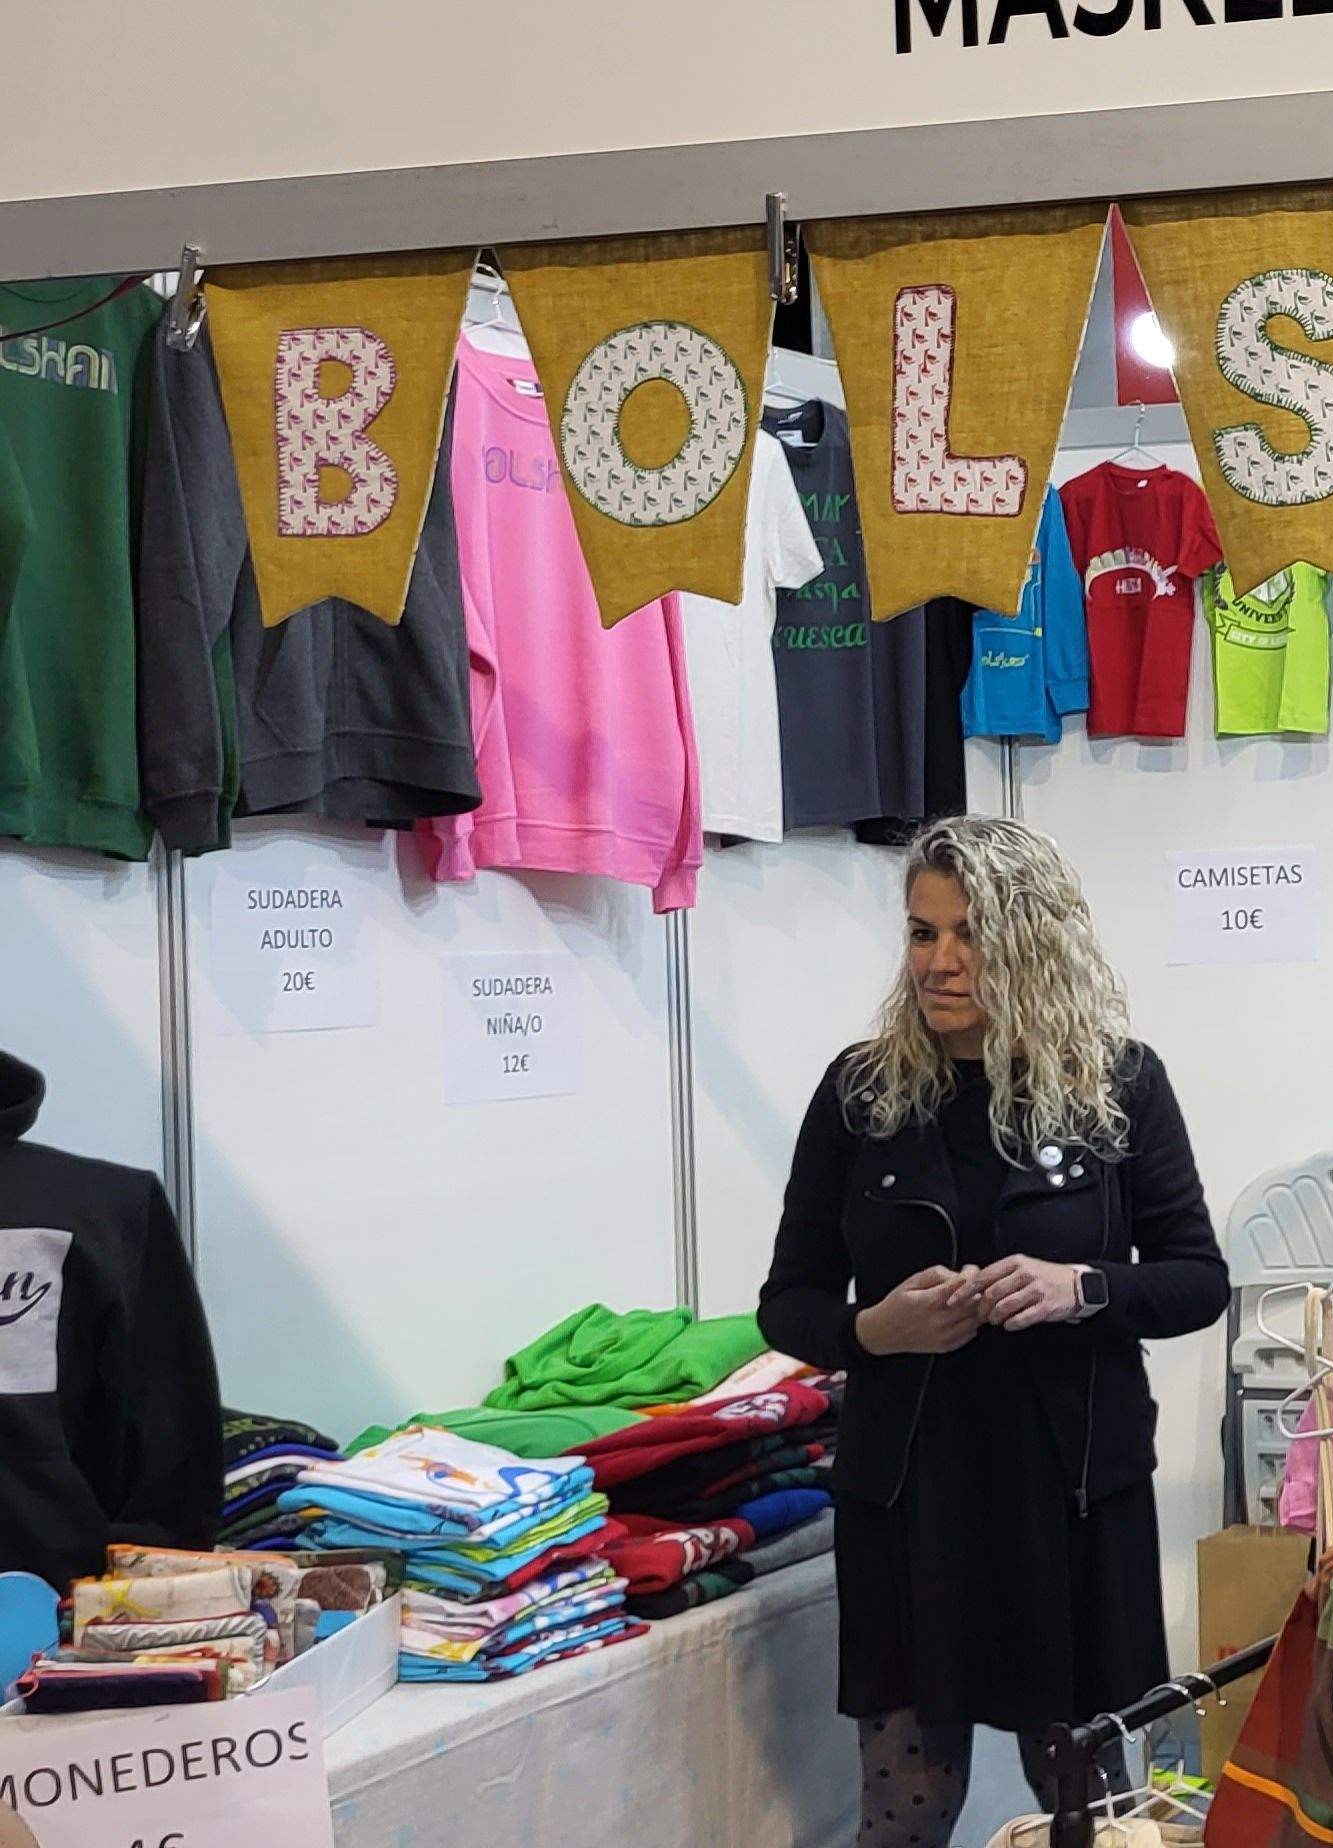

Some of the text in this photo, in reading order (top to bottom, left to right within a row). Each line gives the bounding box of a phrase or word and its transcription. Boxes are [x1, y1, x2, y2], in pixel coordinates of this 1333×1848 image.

[1177, 863, 1303, 889] CAMISETAS
[247, 889, 343, 910] SUDADERA
[1220, 907, 1264, 931] 10€
[260, 928, 333, 950] ADULTO
[282, 971, 316, 992] 20€
[471, 977, 553, 997] SUDADERA
[486, 1012, 542, 1037] NIÑA/O
[502, 1054, 530, 1074] 12€
